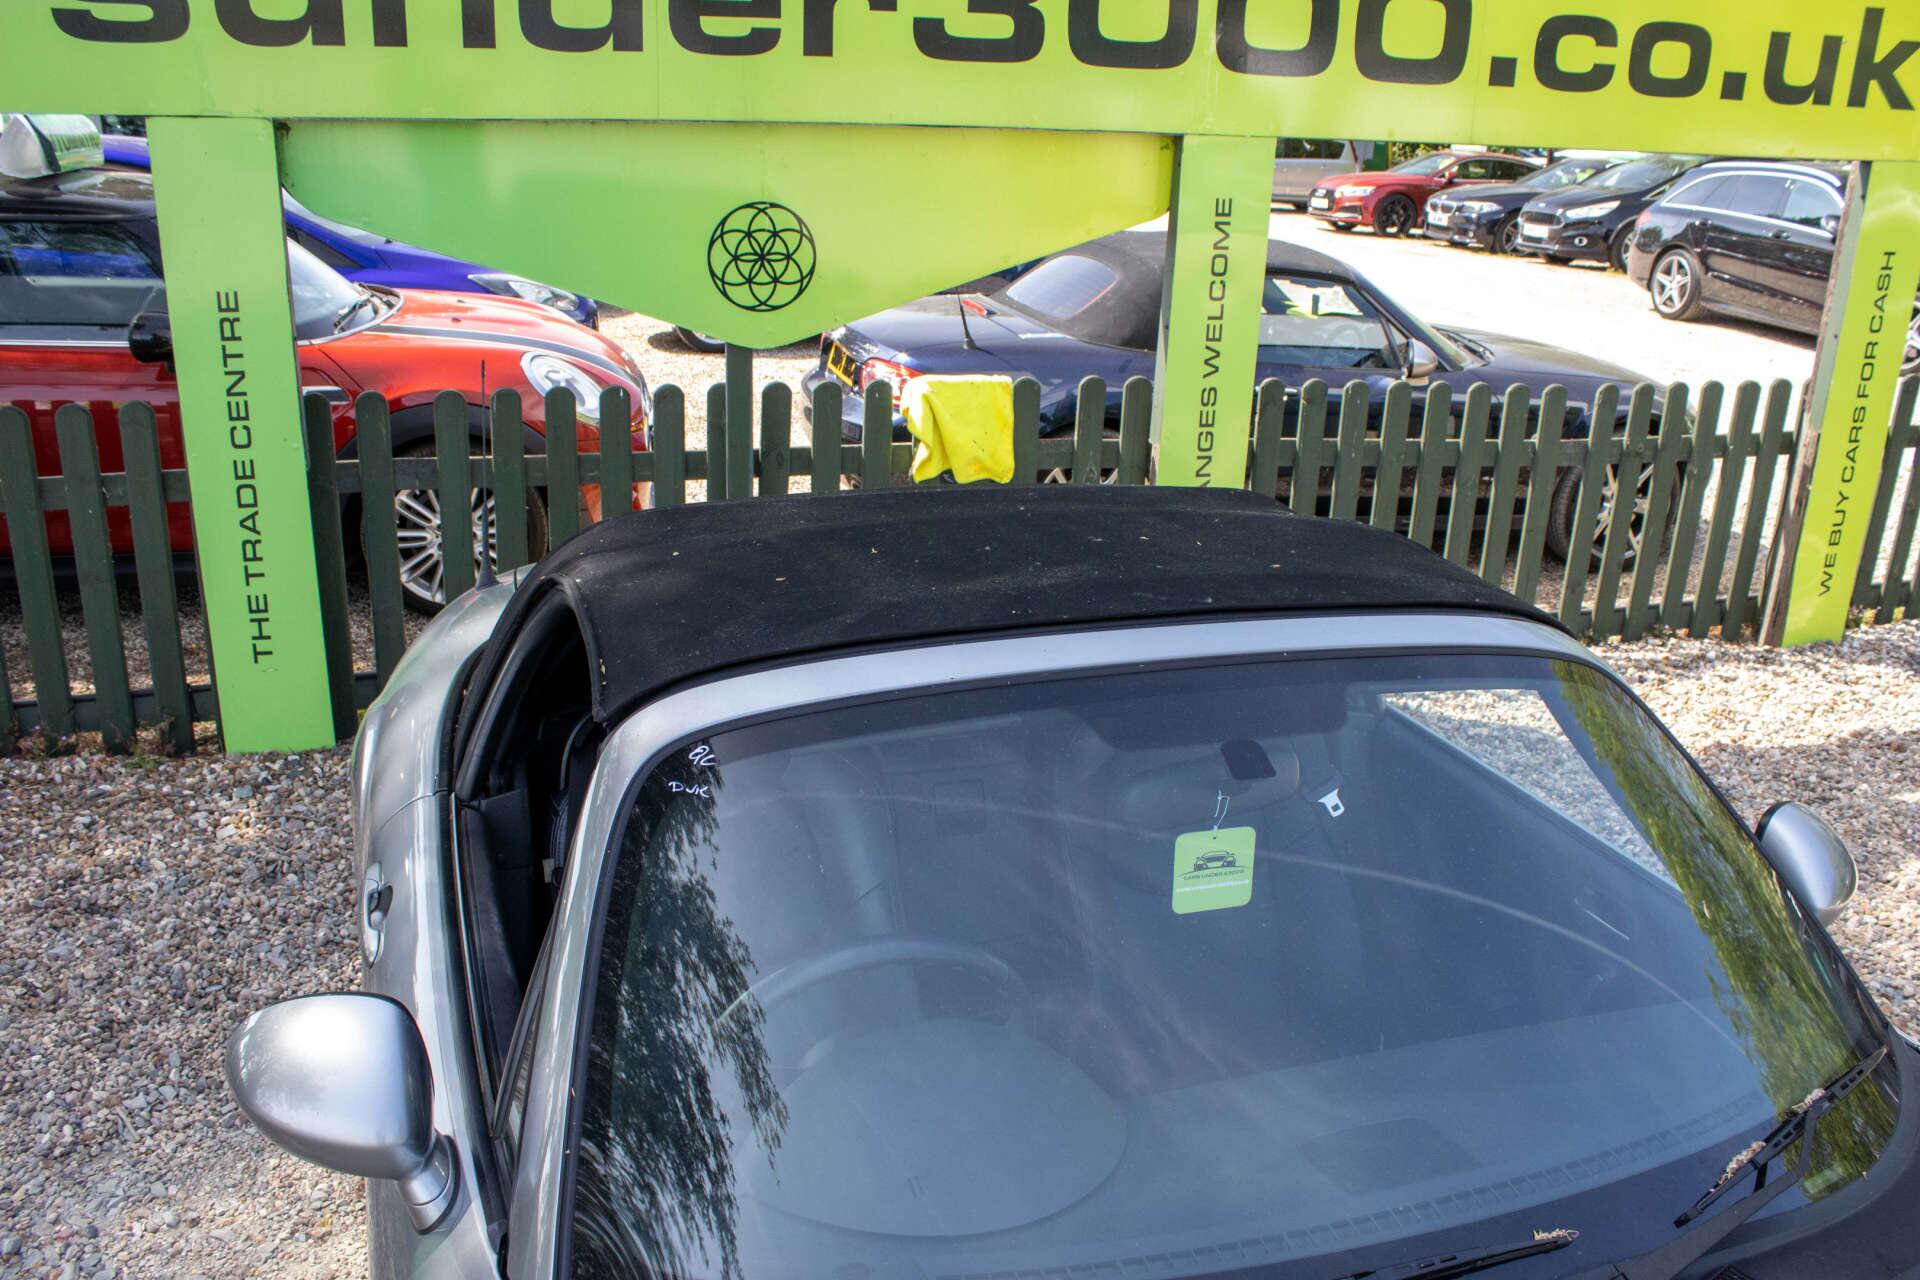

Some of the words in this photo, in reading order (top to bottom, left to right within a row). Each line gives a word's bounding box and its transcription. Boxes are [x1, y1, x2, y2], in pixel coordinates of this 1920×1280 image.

[1202, 198, 1232, 379] WELCOME
[216, 291, 252, 449] CENTRE
[1819, 553, 1837, 597] WE
[1829, 491, 1849, 546] BUY
[1842, 405, 1866, 483] CARS
[1857, 341, 1879, 398] FOR
[1869, 251, 1896, 333] CASH
[233, 458, 265, 586] TRADE
[247, 594, 273, 664] THE
